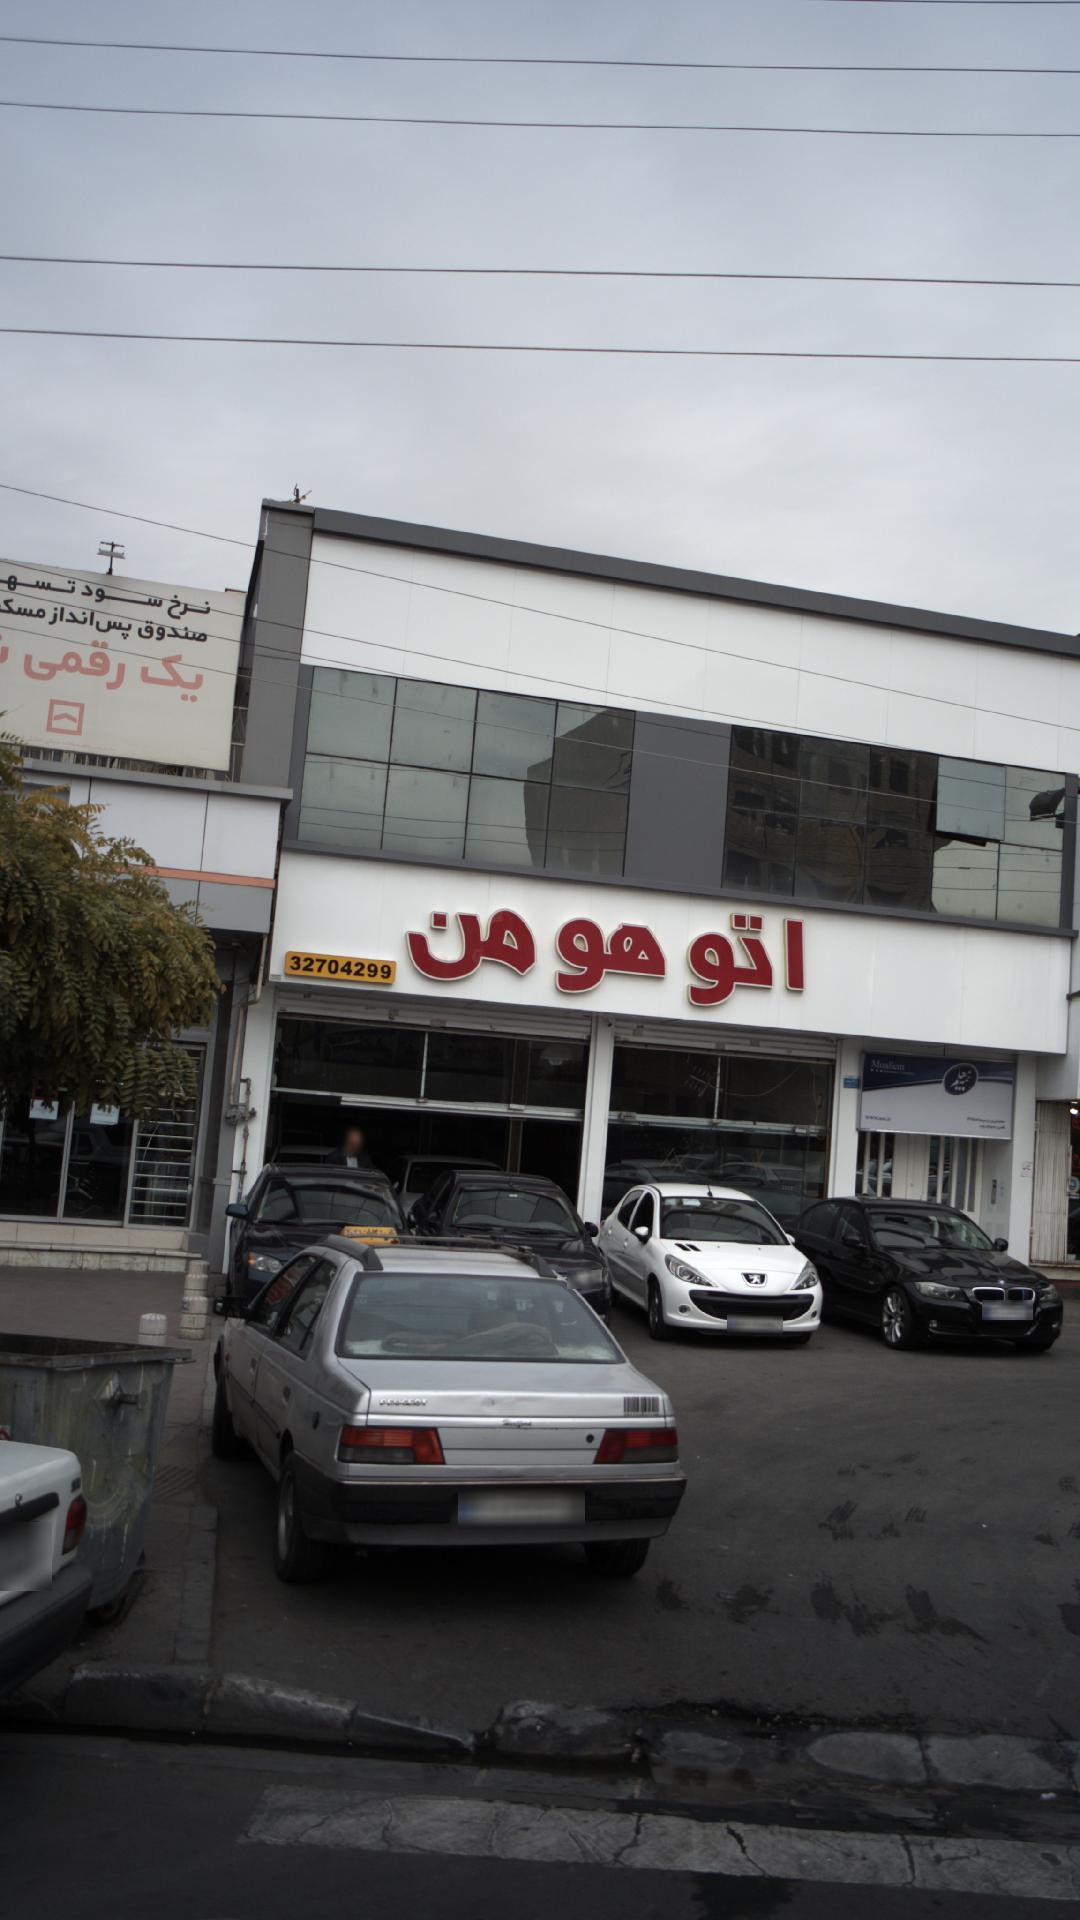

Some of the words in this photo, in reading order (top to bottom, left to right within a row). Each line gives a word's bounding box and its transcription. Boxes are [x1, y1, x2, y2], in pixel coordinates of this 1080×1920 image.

[81, 582, 163, 608] سود
[167, 594, 211, 619] نرخ
[0, 598, 46, 619] مسک
[138, 620, 208, 642] صندوق
[23, 639, 126, 690] رقمی
[140, 654, 204, 703] یک
[289, 955, 392, 979] 32704299
[687, 912, 807, 1006] اتو
